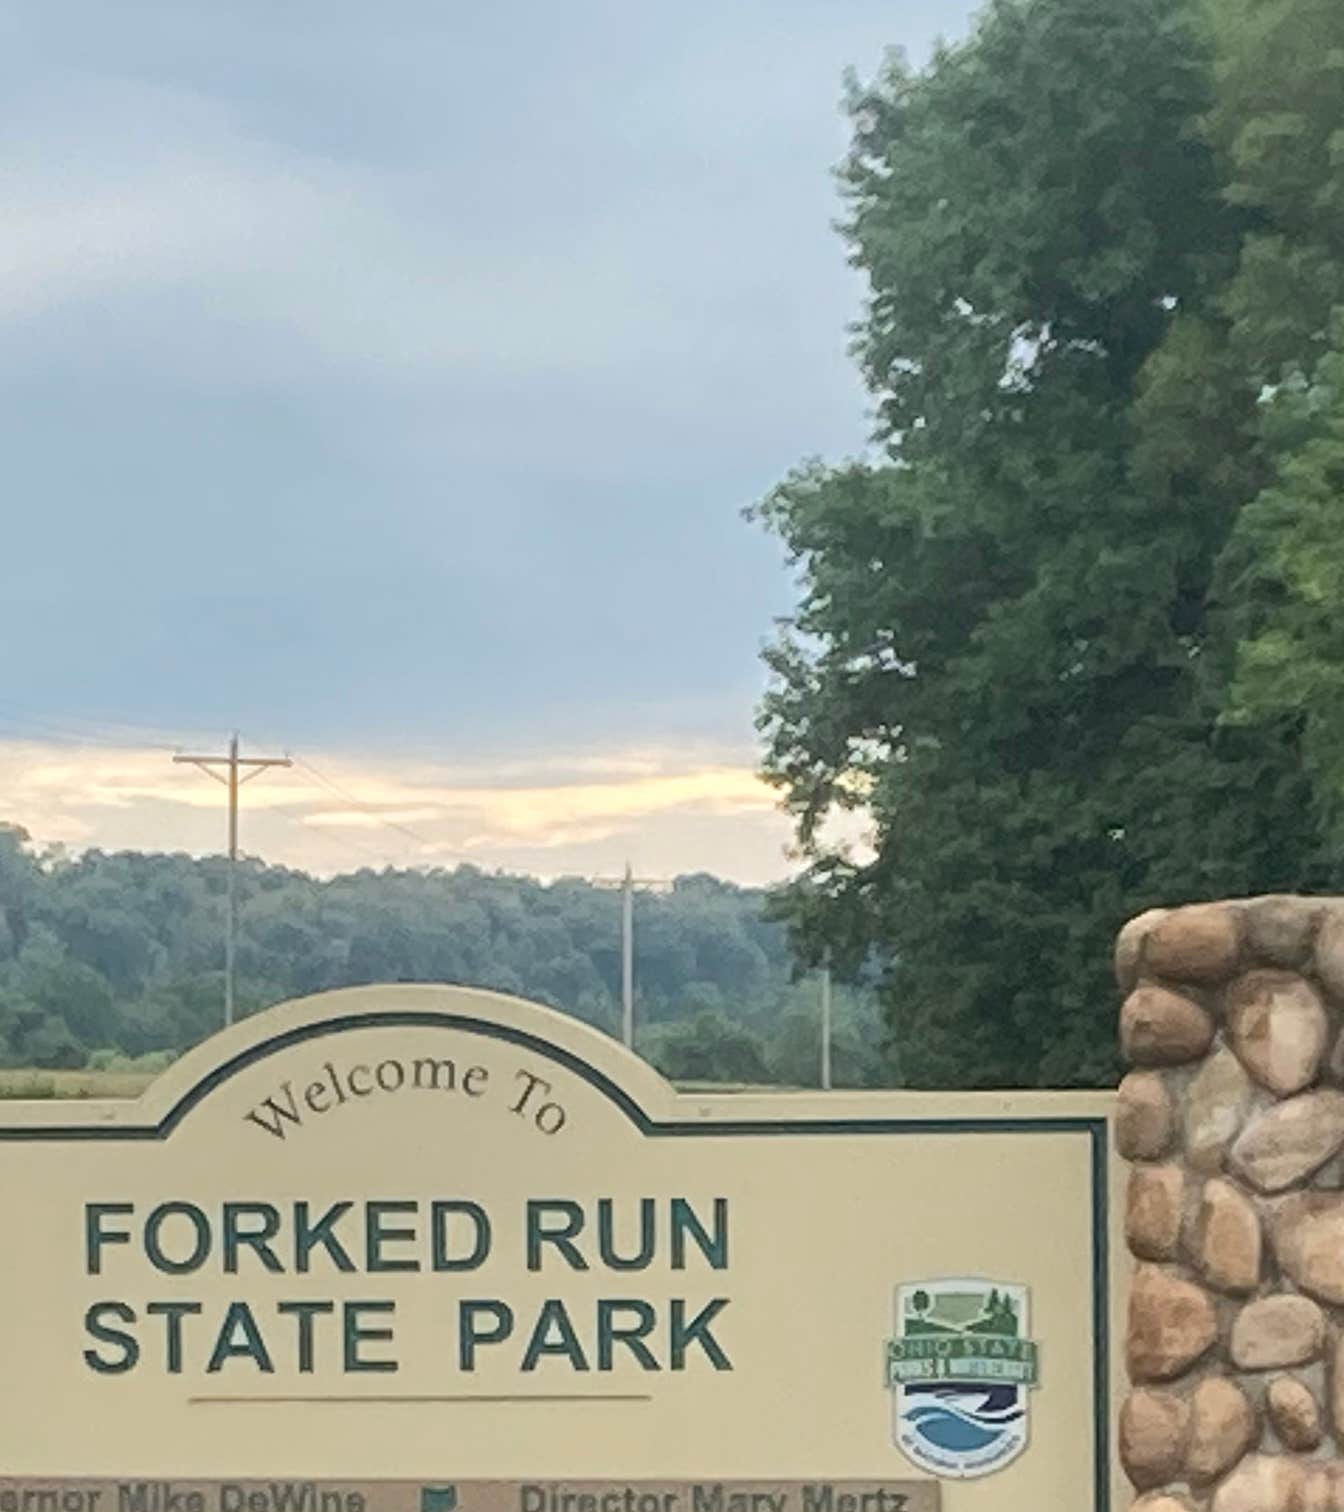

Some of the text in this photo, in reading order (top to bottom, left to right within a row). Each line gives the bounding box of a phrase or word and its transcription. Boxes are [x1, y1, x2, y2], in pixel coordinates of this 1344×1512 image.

[243, 1056, 566, 1141] Welcome To
[84, 1197, 729, 1275] FORKED RUN
[82, 1298, 734, 1374] STATE PARK
